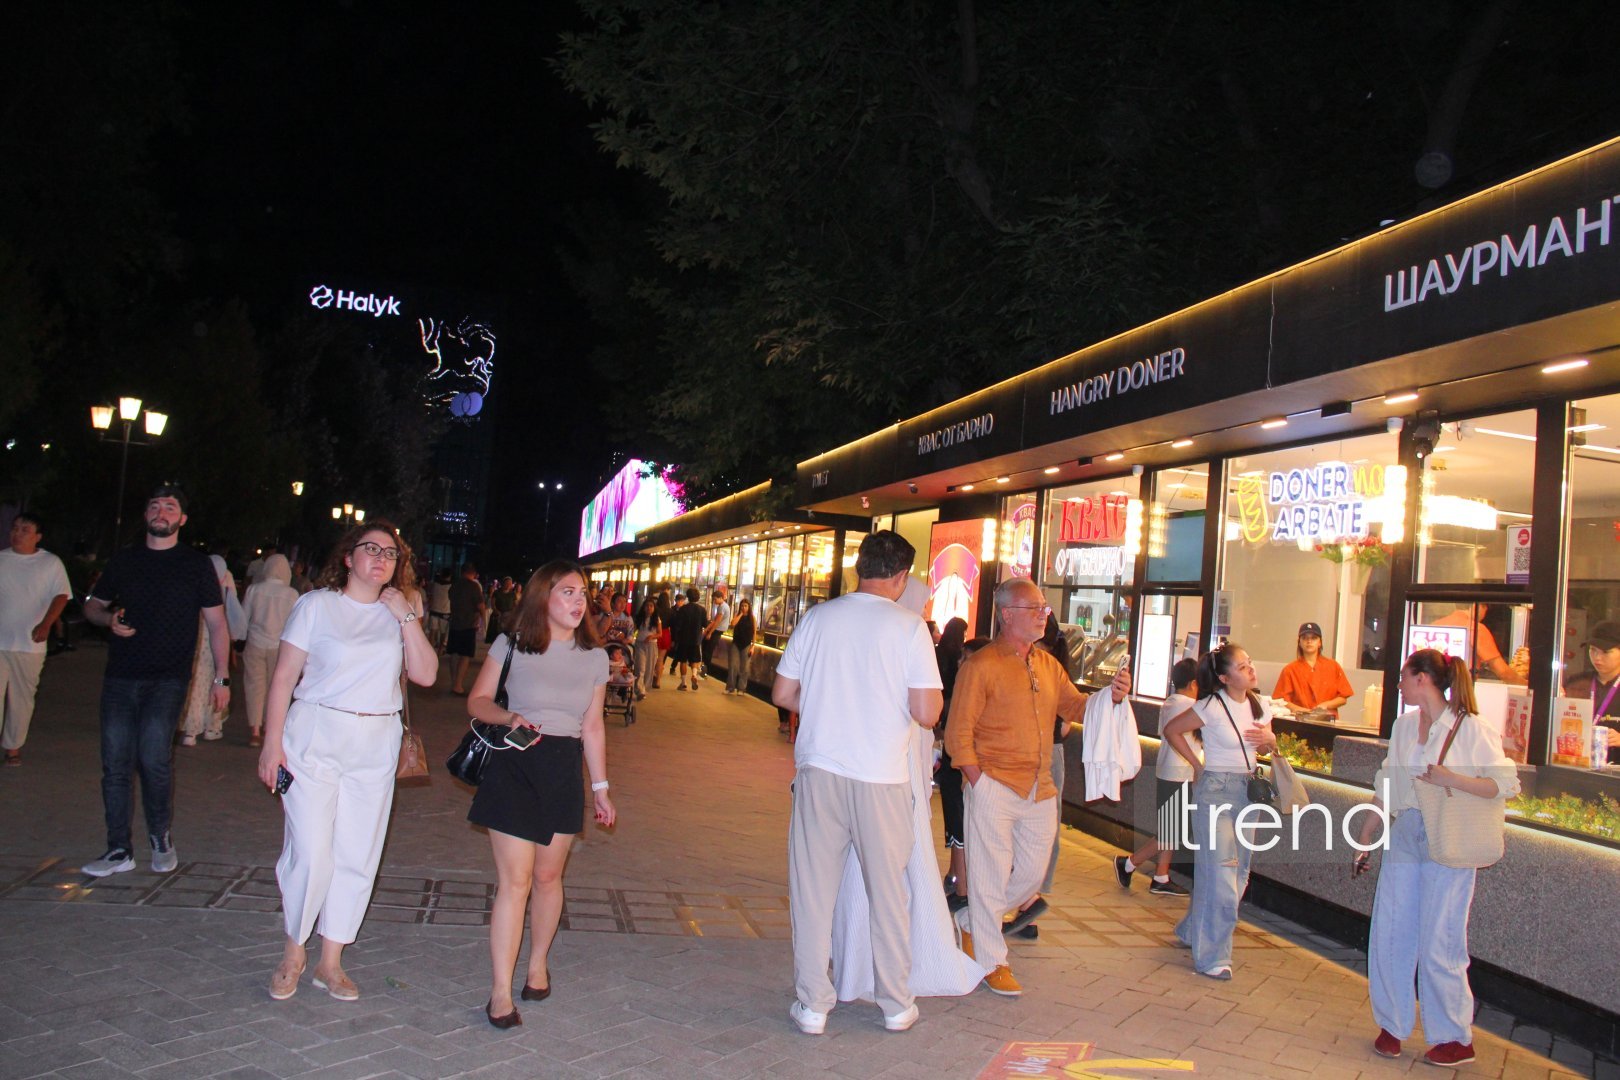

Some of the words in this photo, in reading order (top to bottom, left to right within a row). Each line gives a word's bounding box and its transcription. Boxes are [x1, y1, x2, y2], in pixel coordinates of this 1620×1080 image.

[1384, 194, 1620, 312] ШАУРМАН
[336, 289, 400, 317] Halyk
[1050, 370, 1115, 415] HANGRY
[1116, 347, 1185, 395] DONER
[918, 430, 942, 456] КВАС
[956, 413, 994, 444] БАРНО
[1270, 464, 1349, 503] DONER
[1273, 502, 1363, 540] ARBATE
